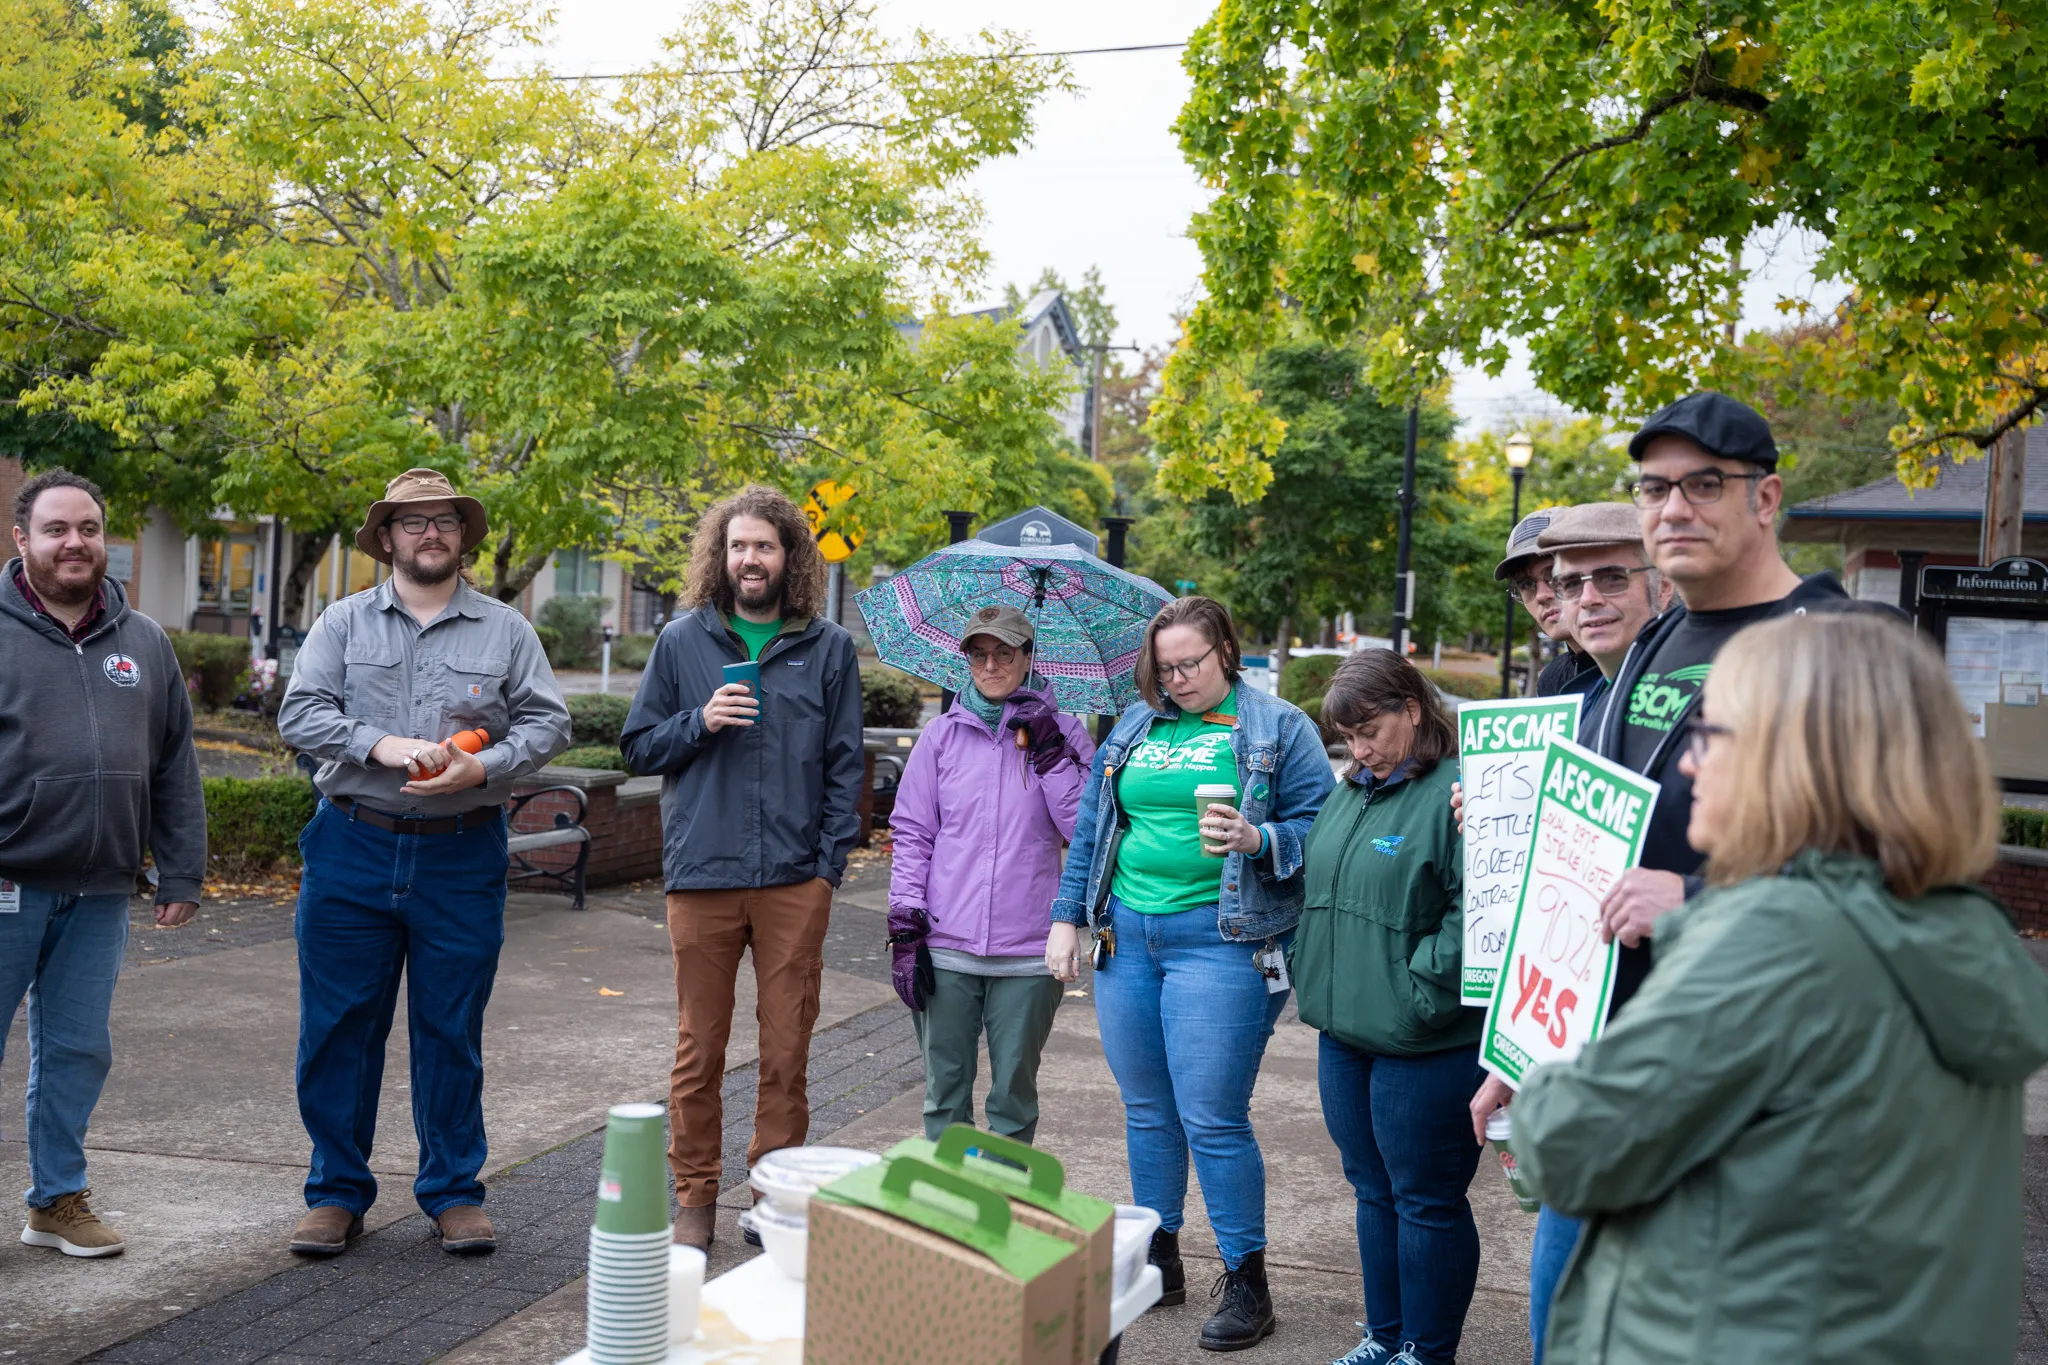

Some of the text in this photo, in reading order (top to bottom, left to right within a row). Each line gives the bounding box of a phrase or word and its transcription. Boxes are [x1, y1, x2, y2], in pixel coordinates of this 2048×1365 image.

[1956, 573, 2037, 591] Information
[1463, 712, 1568, 752] AFSCME
[1130, 744, 1219, 763] AFSCME
[1149, 762, 1182, 770] Coallis
[1184, 763, 1218, 772] Happen
[1544, 757, 1643, 840] AFSCME
[1466, 813, 1532, 846] SETTLE
[1473, 848, 1526, 879] GREA
[1468, 916, 1507, 955] TODA
[1464, 968, 1497, 983] OREGON
[1511, 954, 1578, 1049] YES
